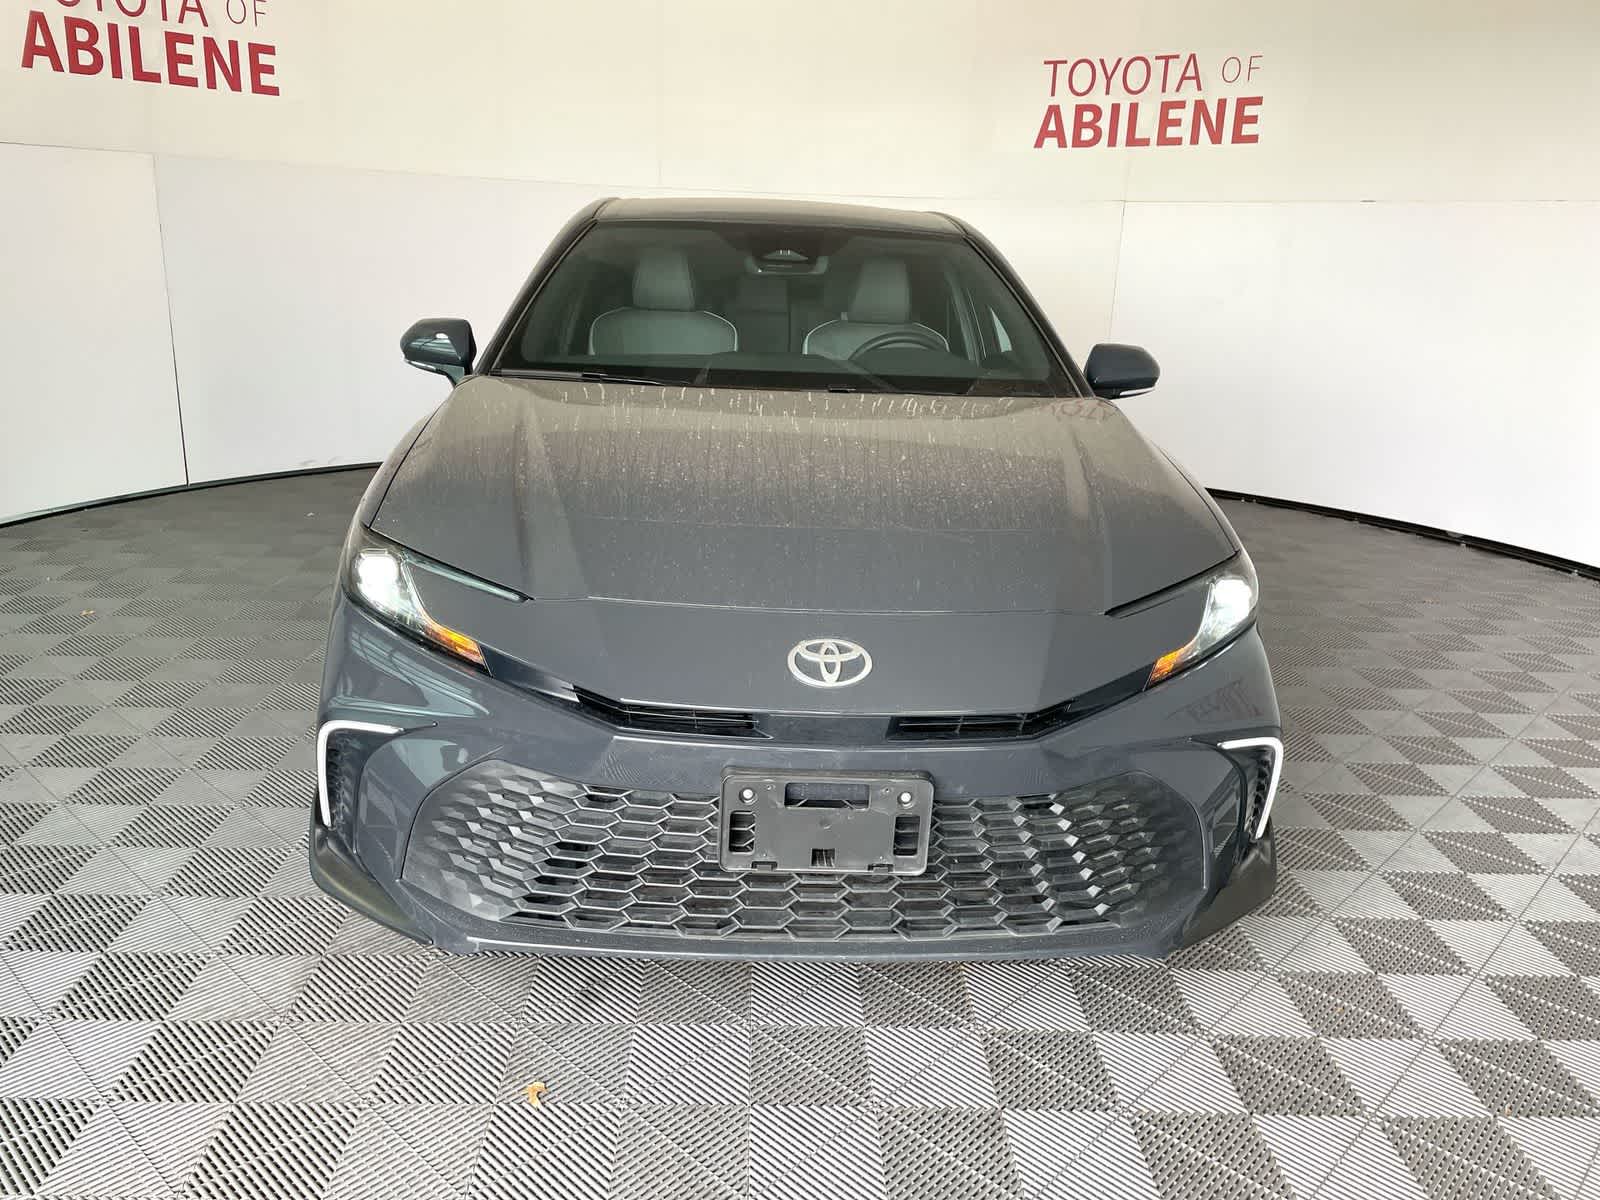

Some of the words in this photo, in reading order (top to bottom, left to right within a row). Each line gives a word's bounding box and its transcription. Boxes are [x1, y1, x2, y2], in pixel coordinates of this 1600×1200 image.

[226, 0, 266, 27] OF
[21, 10, 280, 97] ABILENE
[1043, 53, 1202, 97] TOYOTA
[1222, 55, 1263, 83] OF
[1033, 96, 1263, 148] ABILENE
